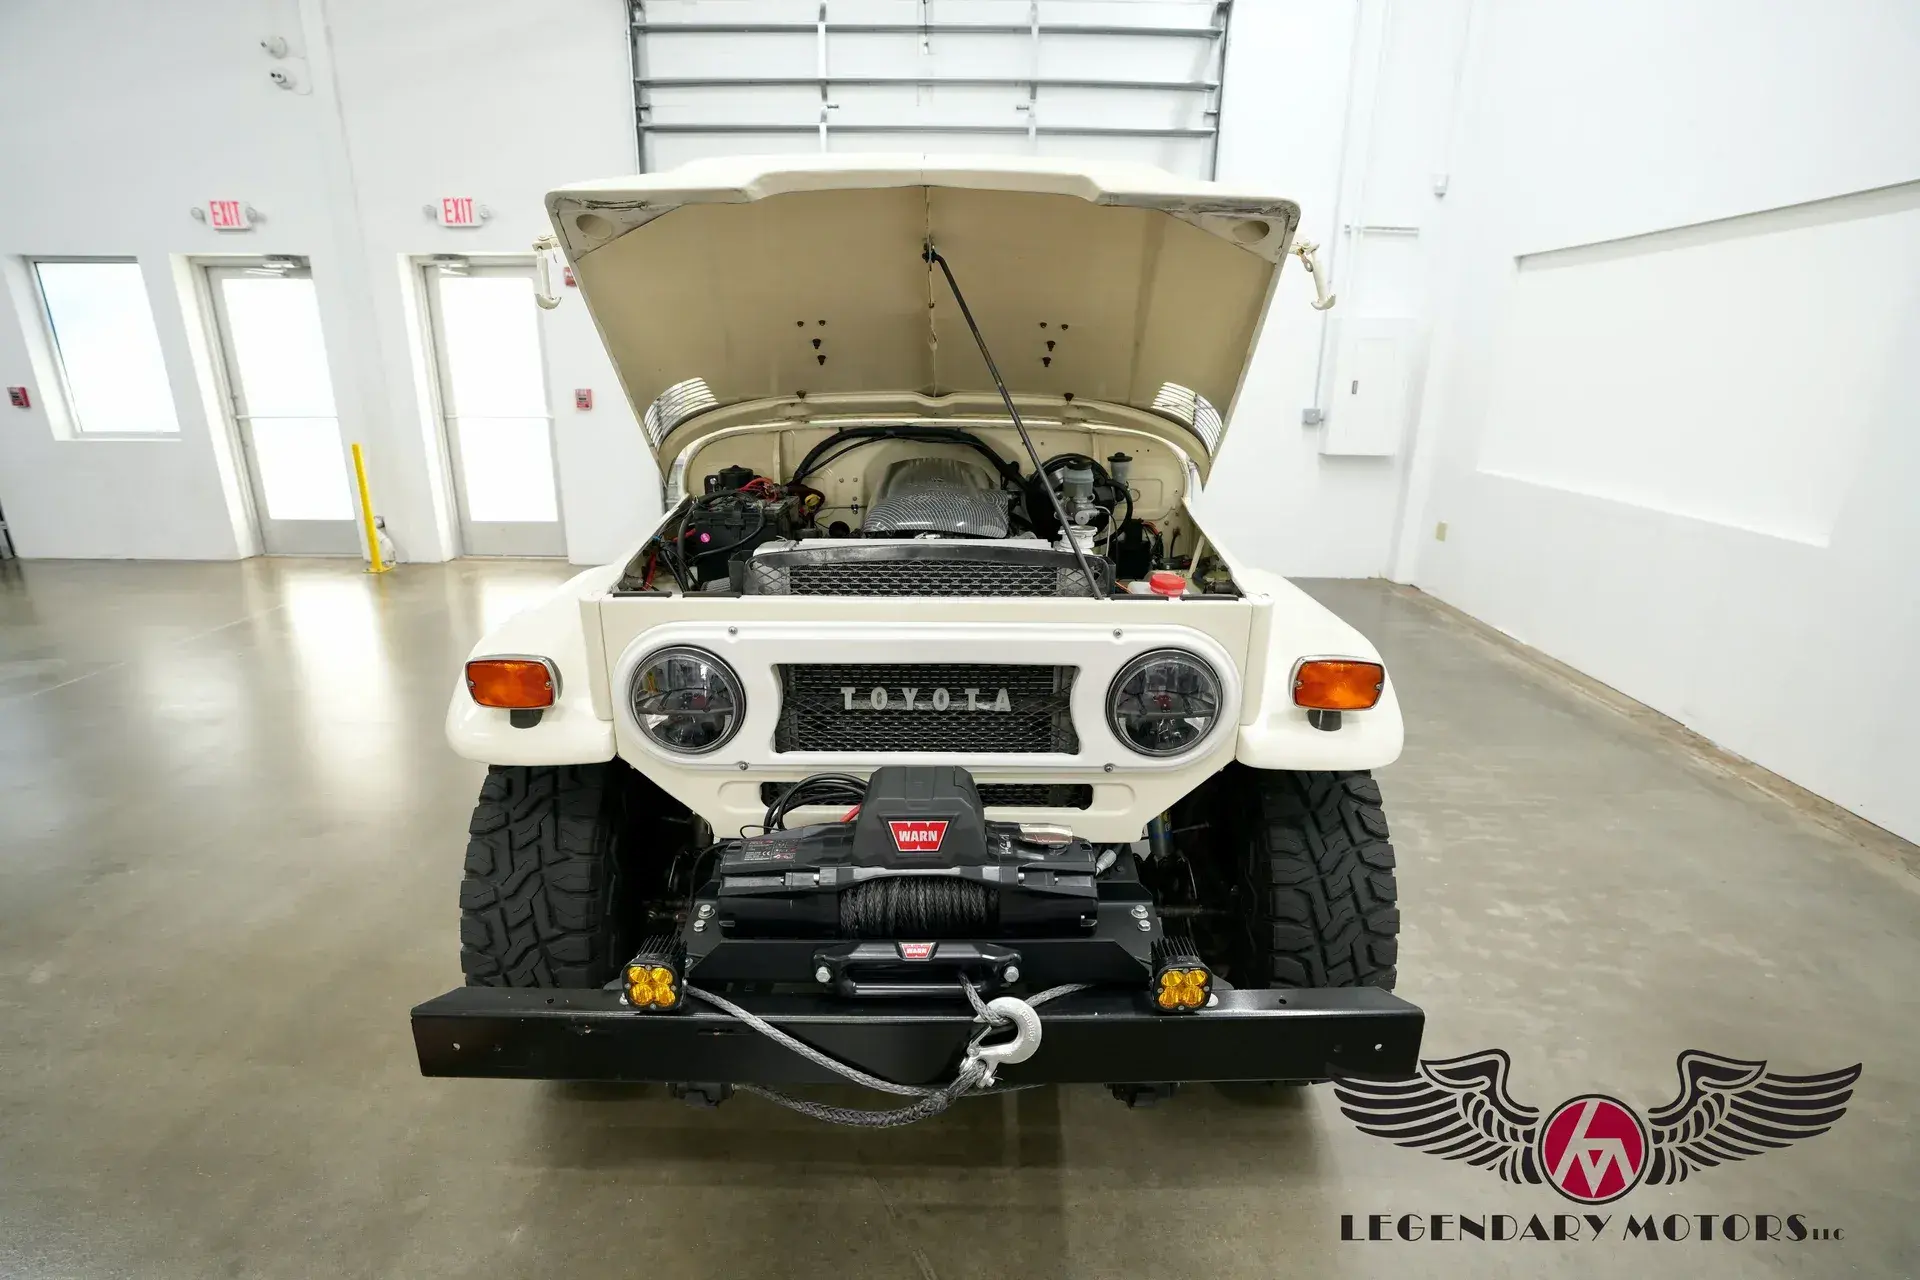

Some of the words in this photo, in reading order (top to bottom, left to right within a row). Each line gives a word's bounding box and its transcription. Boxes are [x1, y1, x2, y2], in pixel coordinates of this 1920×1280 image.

[210, 200, 241, 226] EXIT
[443, 198, 473, 223] EXIT
[840, 686, 1012, 712] TOYOTA
[898, 830, 938, 842] WARN
